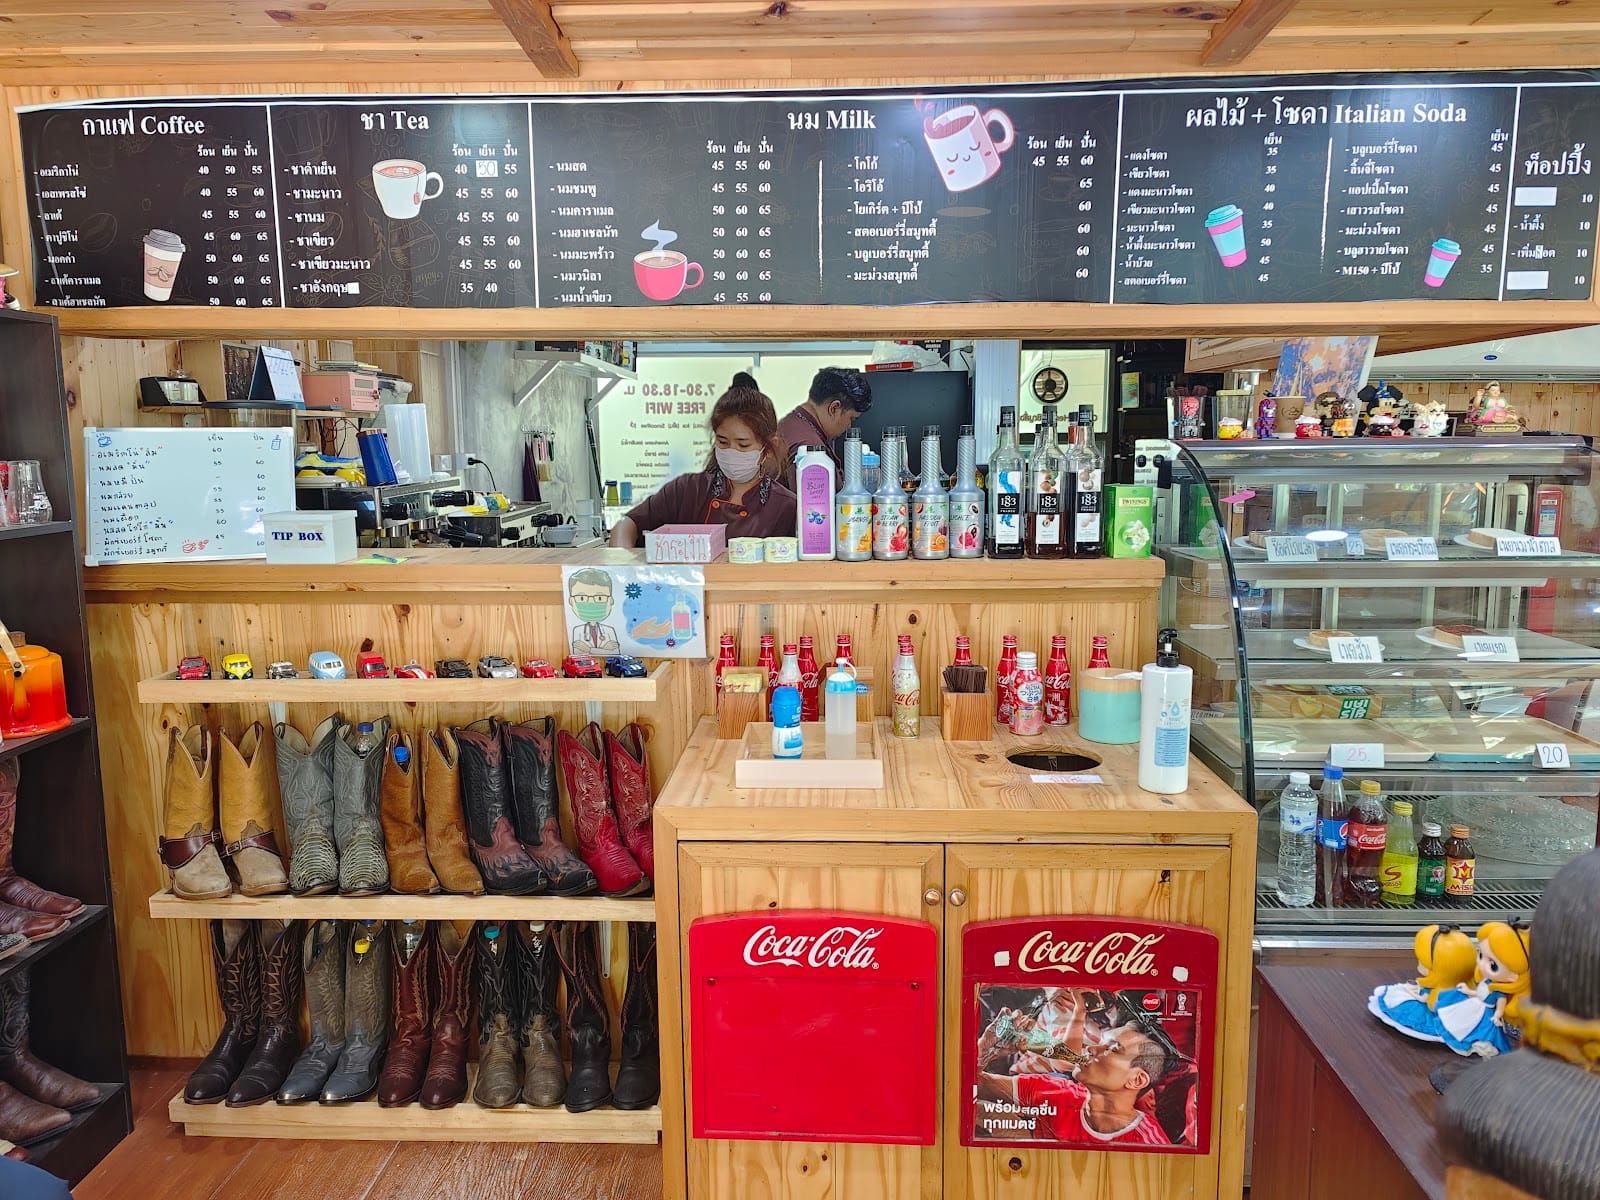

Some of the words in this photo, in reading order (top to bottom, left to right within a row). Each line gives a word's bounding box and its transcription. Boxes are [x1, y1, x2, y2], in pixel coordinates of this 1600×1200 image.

[1186, 96, 1249, 127] ผลไม้
[1271, 95, 1327, 125] โซดา
[1334, 104, 1405, 124] Italian
[1412, 102, 1468, 122] Soda
[82, 109, 134, 136] กาแฟ
[140, 116, 205, 135] Coffee
[360, 111, 385, 131] ชา
[391, 110, 429, 130] Tea
[788, 111, 819, 130] นม
[826, 110, 876, 129] Milk
[706, 139, 726, 154] ร้อน
[733, 140, 750, 154] เย็น
[759, 136, 773, 154] ปั่น
[1027, 135, 1048, 150] ร้อน
[1055, 136, 1072, 149] เย็น
[1081, 130, 1096, 149] ปั่น
[197, 144, 215, 157] ร้อน
[222, 144, 237, 157] เย็น
[452, 144, 472, 157] ร้อน
[479, 144, 495, 156] เย็น
[503, 139, 518, 156] ปั่น
[1491, 143, 1503, 152] 45
[854, 155, 879, 170] โกโก้
[1032, 156, 1046, 167] 45
[1056, 156, 1070, 166] 55
[1080, 155, 1093, 166] 60
[1524, 143, 1592, 175] ท็อปปิ้ง
[198, 165, 209, 175] 40
[225, 165, 236, 175] 50
[251, 165, 263, 175] 55
[712, 161, 724, 170] 45
[735, 161, 748, 170] 55
[759, 161, 771, 170] 60
[1489, 163, 1502, 173] 45
[712, 183, 724, 193] 45
[735, 183, 748, 193] 55
[759, 183, 771, 193] 60
[1079, 178, 1093, 189] 65
[1487, 184, 1500, 193] 45
[200, 188, 211, 197] 40
[227, 188, 237, 197] 55
[253, 188, 264, 197] 60
[293, 189, 342, 199] ชามะนาว
[456, 189, 468, 199] 45
[480, 189, 493, 199] 55
[505, 189, 518, 199] 60
[713, 205, 725, 215] 50
[736, 205, 748, 215] 60
[759, 205, 771, 215] 65
[1078, 201, 1092, 212] 60
[1486, 204, 1498, 214] 45
[202, 210, 213, 220] 45
[229, 210, 239, 220] 55
[255, 210, 266, 220] 60
[295, 213, 325, 223] ชานม
[457, 212, 470, 222] 45
[482, 212, 495, 222] 55
[506, 212, 519, 222] 60
[713, 227, 725, 237] 50
[736, 227, 748, 237] 60
[759, 227, 771, 237] 65
[1077, 224, 1091, 234] 60
[1484, 224, 1496, 234] 45
[204, 232, 214, 242] 45
[257, 232, 268, 242] 65
[296, 232, 334, 246] ชาเขียว
[458, 236, 471, 246] 45
[483, 236, 495, 246] 55
[507, 236, 520, 246] 60
[1076, 246, 1090, 256] 60
[1482, 244, 1494, 254] 45
[205, 254, 216, 263] 50
[232, 254, 243, 263] 60
[259, 254, 270, 263] 65
[713, 250, 725, 259] 50
[736, 250, 748, 259] 60
[759, 250, 771, 259] 65
[459, 260, 472, 270] 45
[484, 260, 497, 270] 55
[508, 260, 521, 270] 60
[1075, 268, 1089, 279] 60
[1342, 266, 1369, 275] M150
[207, 276, 218, 285] 50
[234, 276, 245, 285] 60
[713, 271, 725, 281] 50
[736, 271, 748, 281] 60
[759, 271, 771, 281] 65
[460, 283, 473, 293] 35
[485, 283, 498, 293] 40
[209, 297, 220, 306] 50
[713, 293, 725, 302] 45
[736, 293, 748, 302] 55
[759, 293, 771, 302] 60
[1000, 496, 1016, 507] 183
[1041, 496, 1057, 507] 183
[1081, 493, 1097, 506] 183
[271, 531, 293, 542] TIP
[299, 531, 323, 542] BOX
[1542, 745, 1563, 764] 20
[743, 925, 885, 970] Coca-Cola
[1018, 931, 1165, 976] Coca-Cola
[983, 1099, 1057, 1117] พร้อมสดชื่น
[983, 1117, 1037, 1133] ทุกแมตช์
